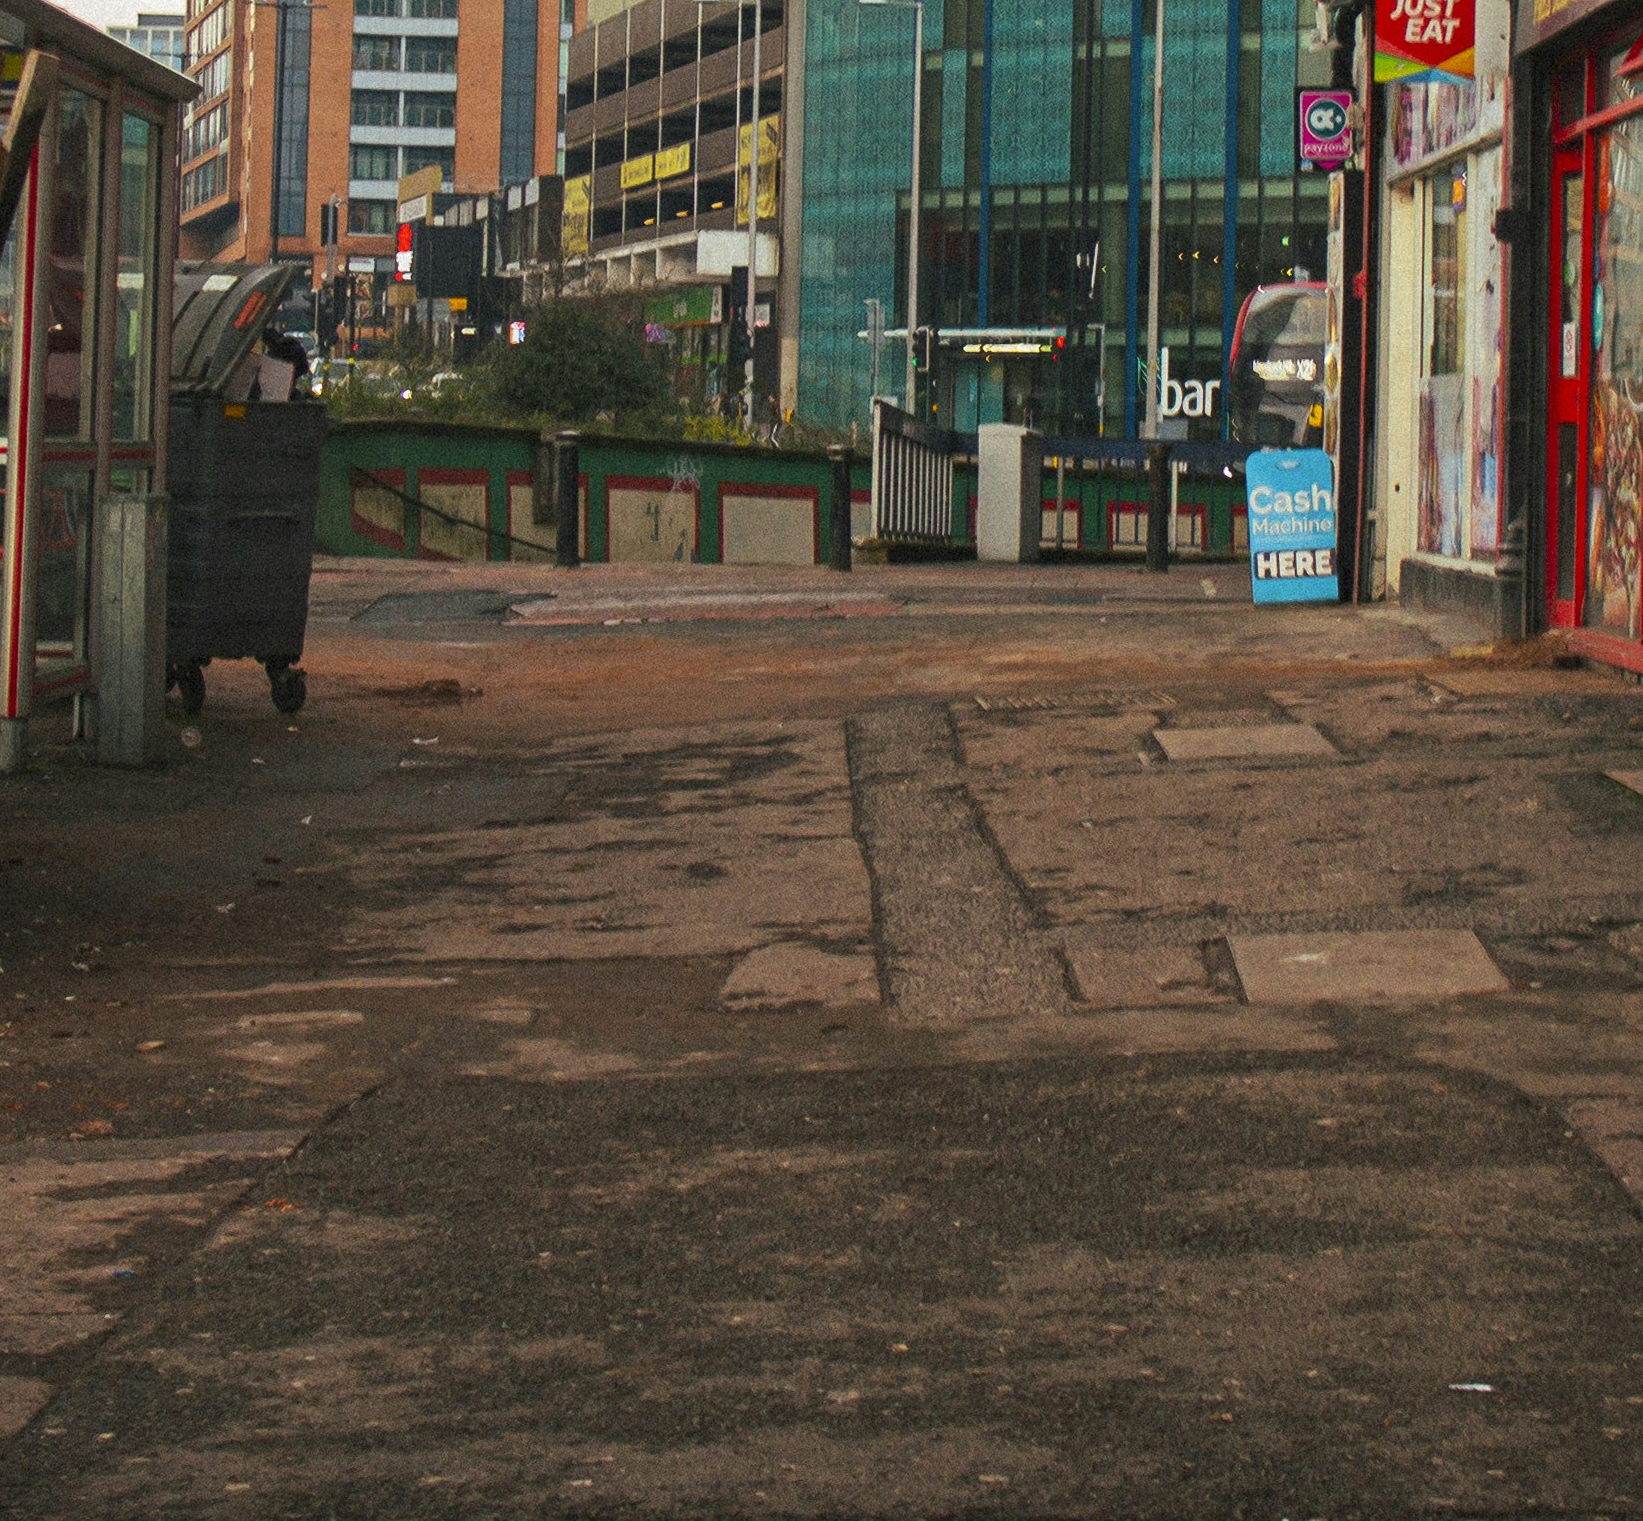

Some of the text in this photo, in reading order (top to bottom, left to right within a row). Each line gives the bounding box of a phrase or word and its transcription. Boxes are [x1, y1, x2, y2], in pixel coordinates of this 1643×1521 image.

[1404, 18, 1461, 45] EAT
[1159, 346, 1222, 418] bar
[1249, 482, 1333, 515] Cash
[1252, 516, 1333, 536] Machine
[1257, 549, 1333, 579] HERE
